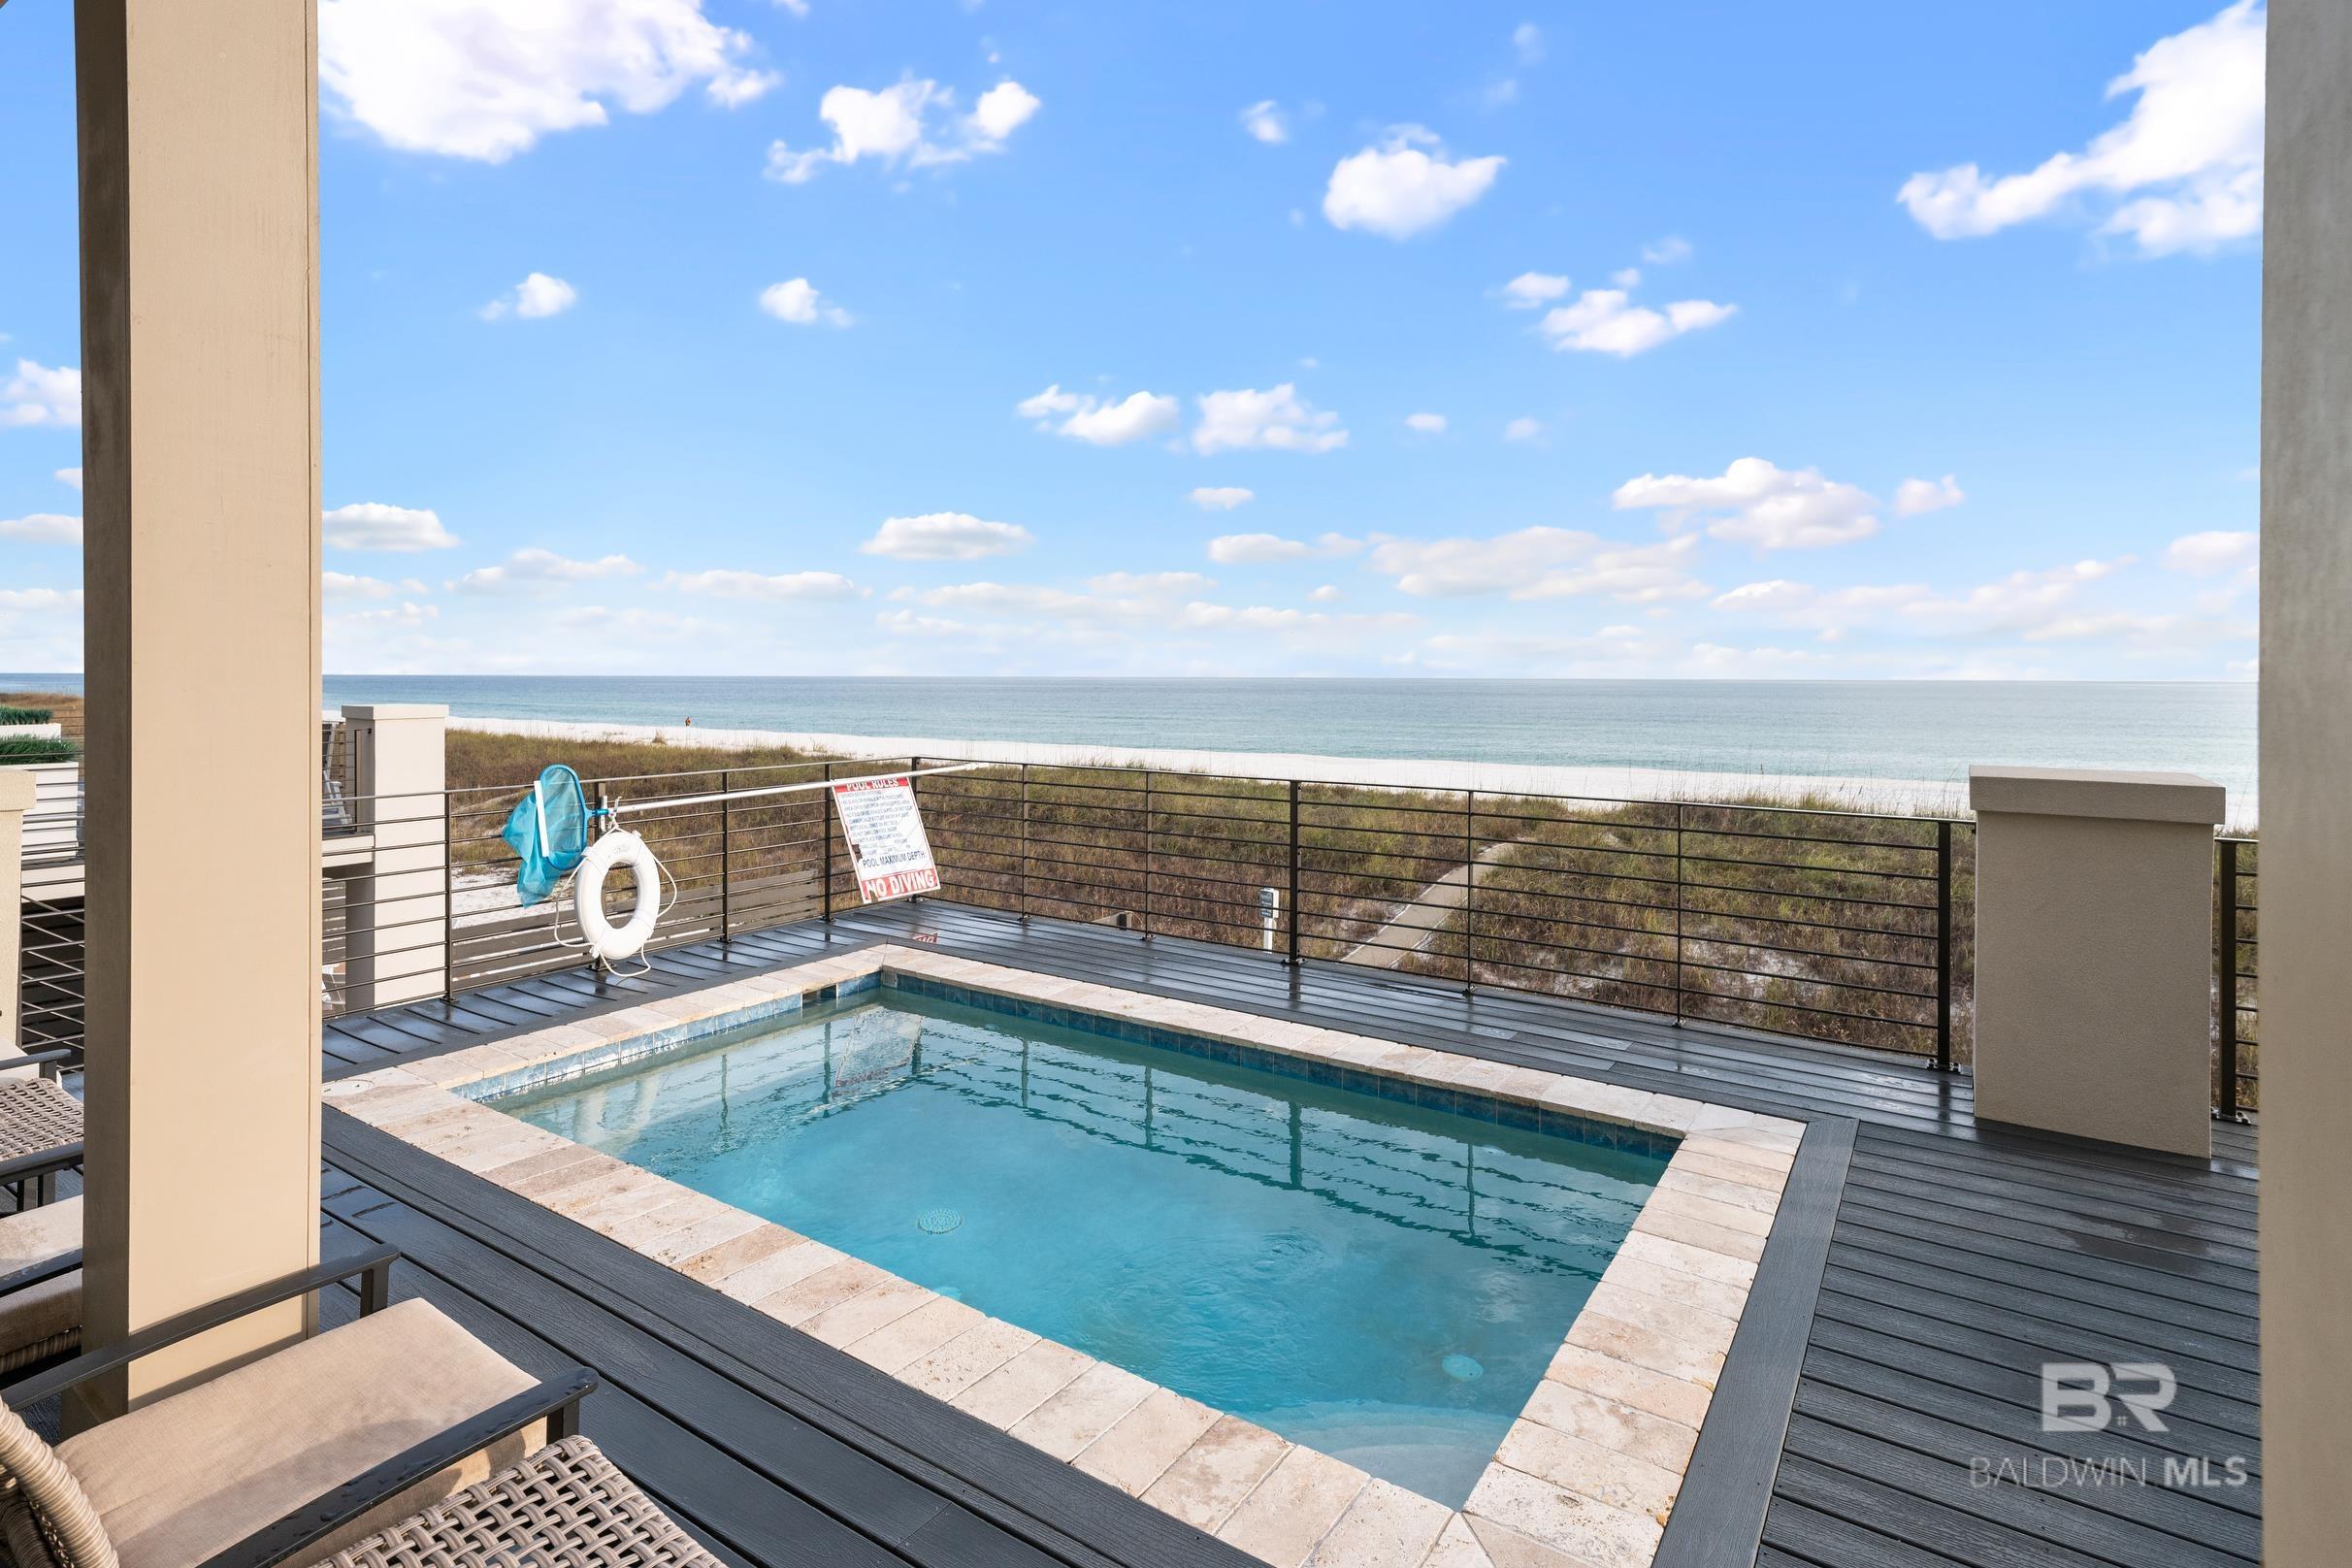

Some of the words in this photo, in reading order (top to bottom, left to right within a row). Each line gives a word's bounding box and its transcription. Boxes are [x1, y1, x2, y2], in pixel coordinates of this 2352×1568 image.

[846, 782, 870, 792] POOL
[872, 777, 898, 788] RULES
[862, 859, 879, 868] POOL
[880, 853, 906, 866] MAXIMUM
[865, 878, 888, 900] NO
[889, 869, 934, 894] DIVING
